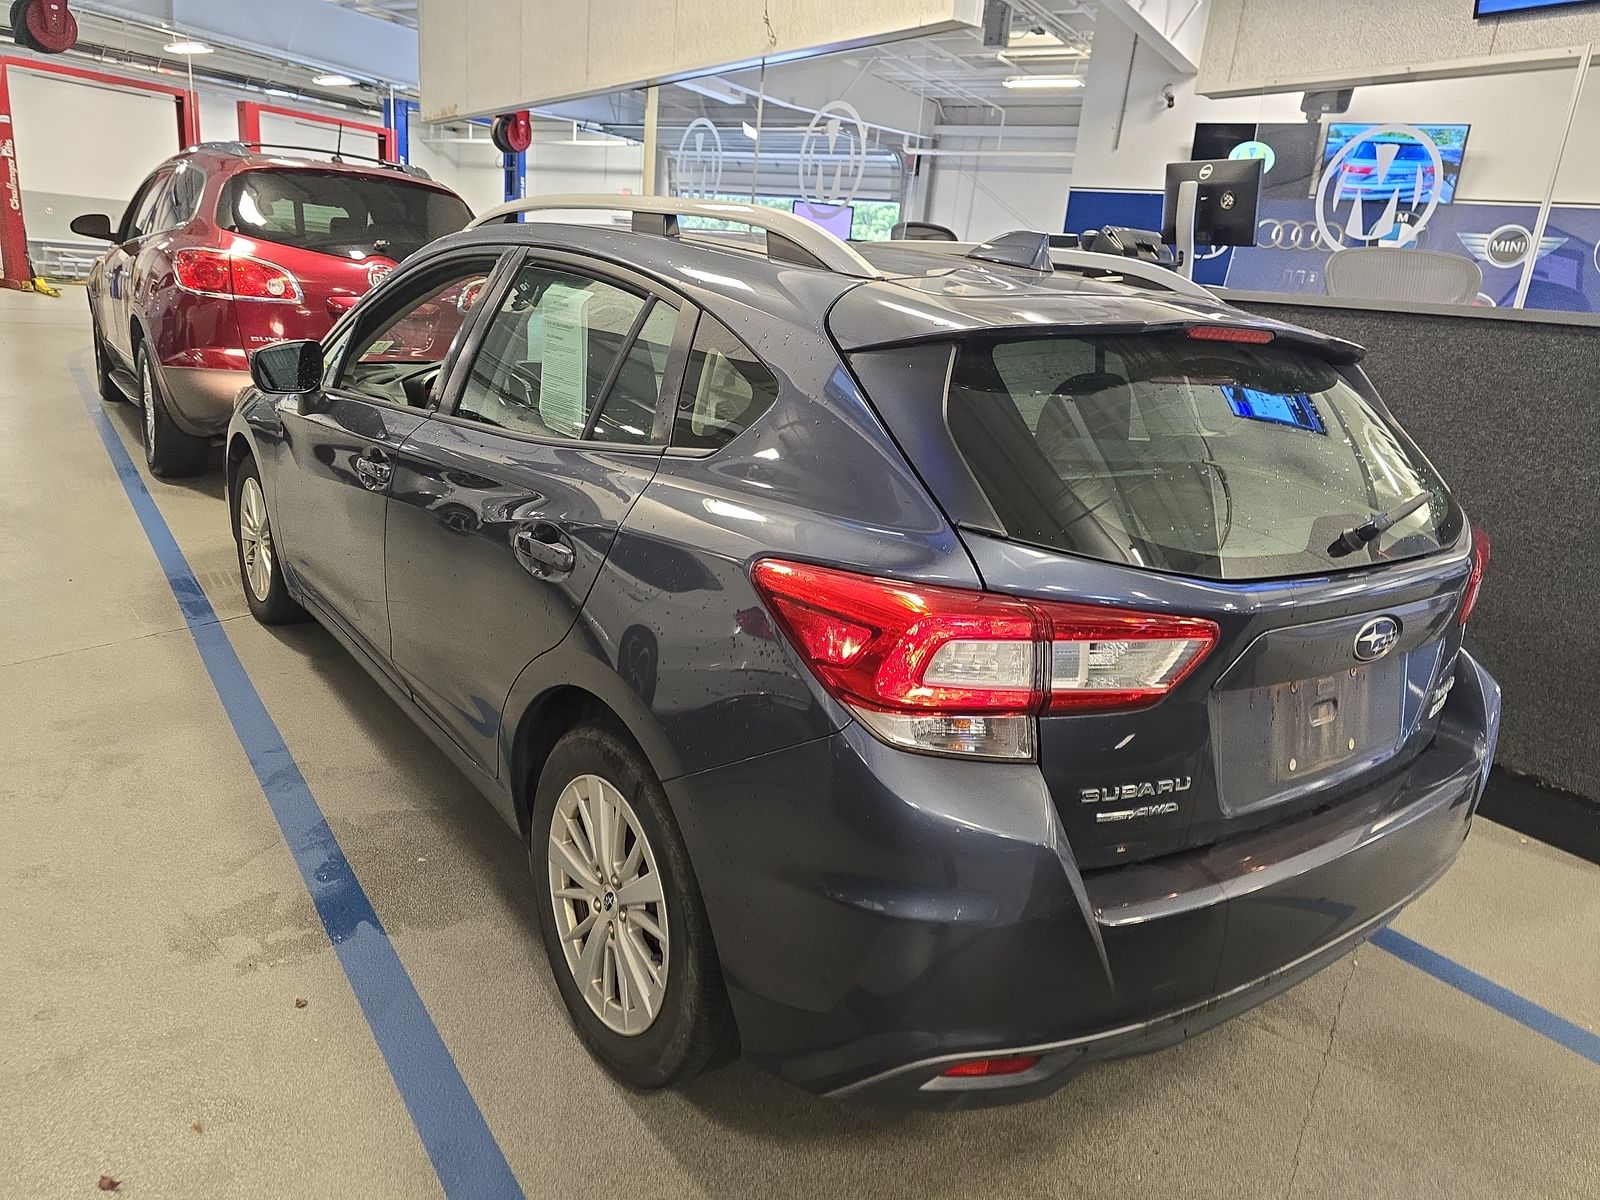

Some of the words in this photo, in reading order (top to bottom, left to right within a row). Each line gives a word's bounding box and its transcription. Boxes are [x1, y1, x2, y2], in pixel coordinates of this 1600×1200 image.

[1491, 240, 1526, 253] MINI
[1081, 776, 1192, 804] SUBARU
[1129, 802, 1179, 819] AWD
